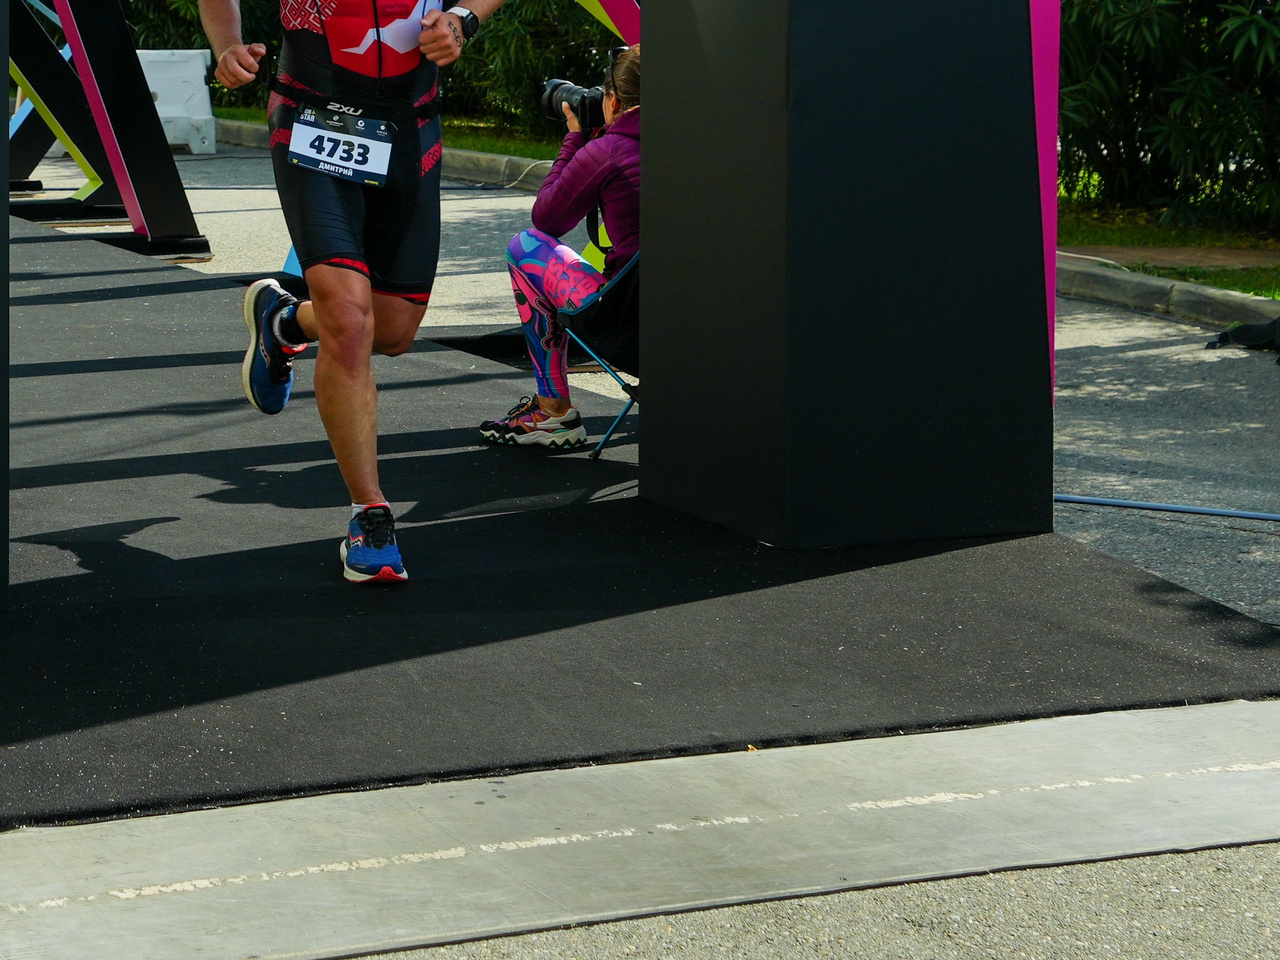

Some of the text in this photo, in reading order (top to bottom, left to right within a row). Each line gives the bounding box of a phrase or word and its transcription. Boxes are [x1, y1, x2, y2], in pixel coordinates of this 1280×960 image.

[326, 101, 364, 116] 2XU
[308, 134, 371, 166] 4733
[318, 161, 354, 177] ДМИТРИЙ
